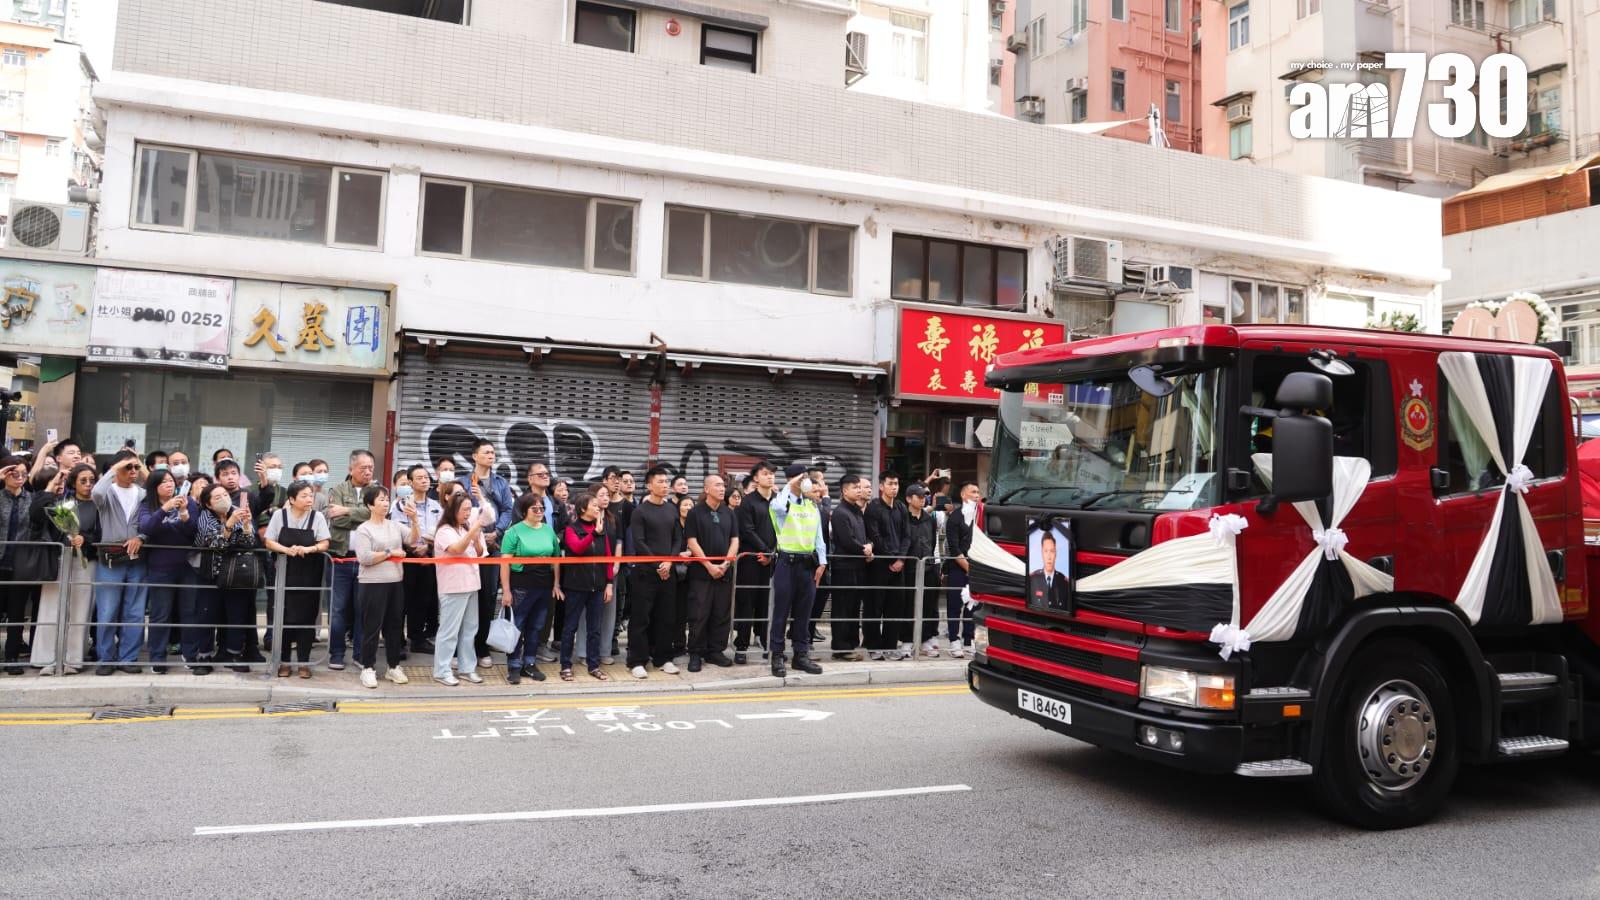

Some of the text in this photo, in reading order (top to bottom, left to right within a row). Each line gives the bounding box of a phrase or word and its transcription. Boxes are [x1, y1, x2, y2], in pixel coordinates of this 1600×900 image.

[181, 311, 223, 328] 0252
[1030, 424, 1053, 433] Street
[1021, 692, 1029, 707] F
[431, 718, 733, 739] LOOK LEFT
